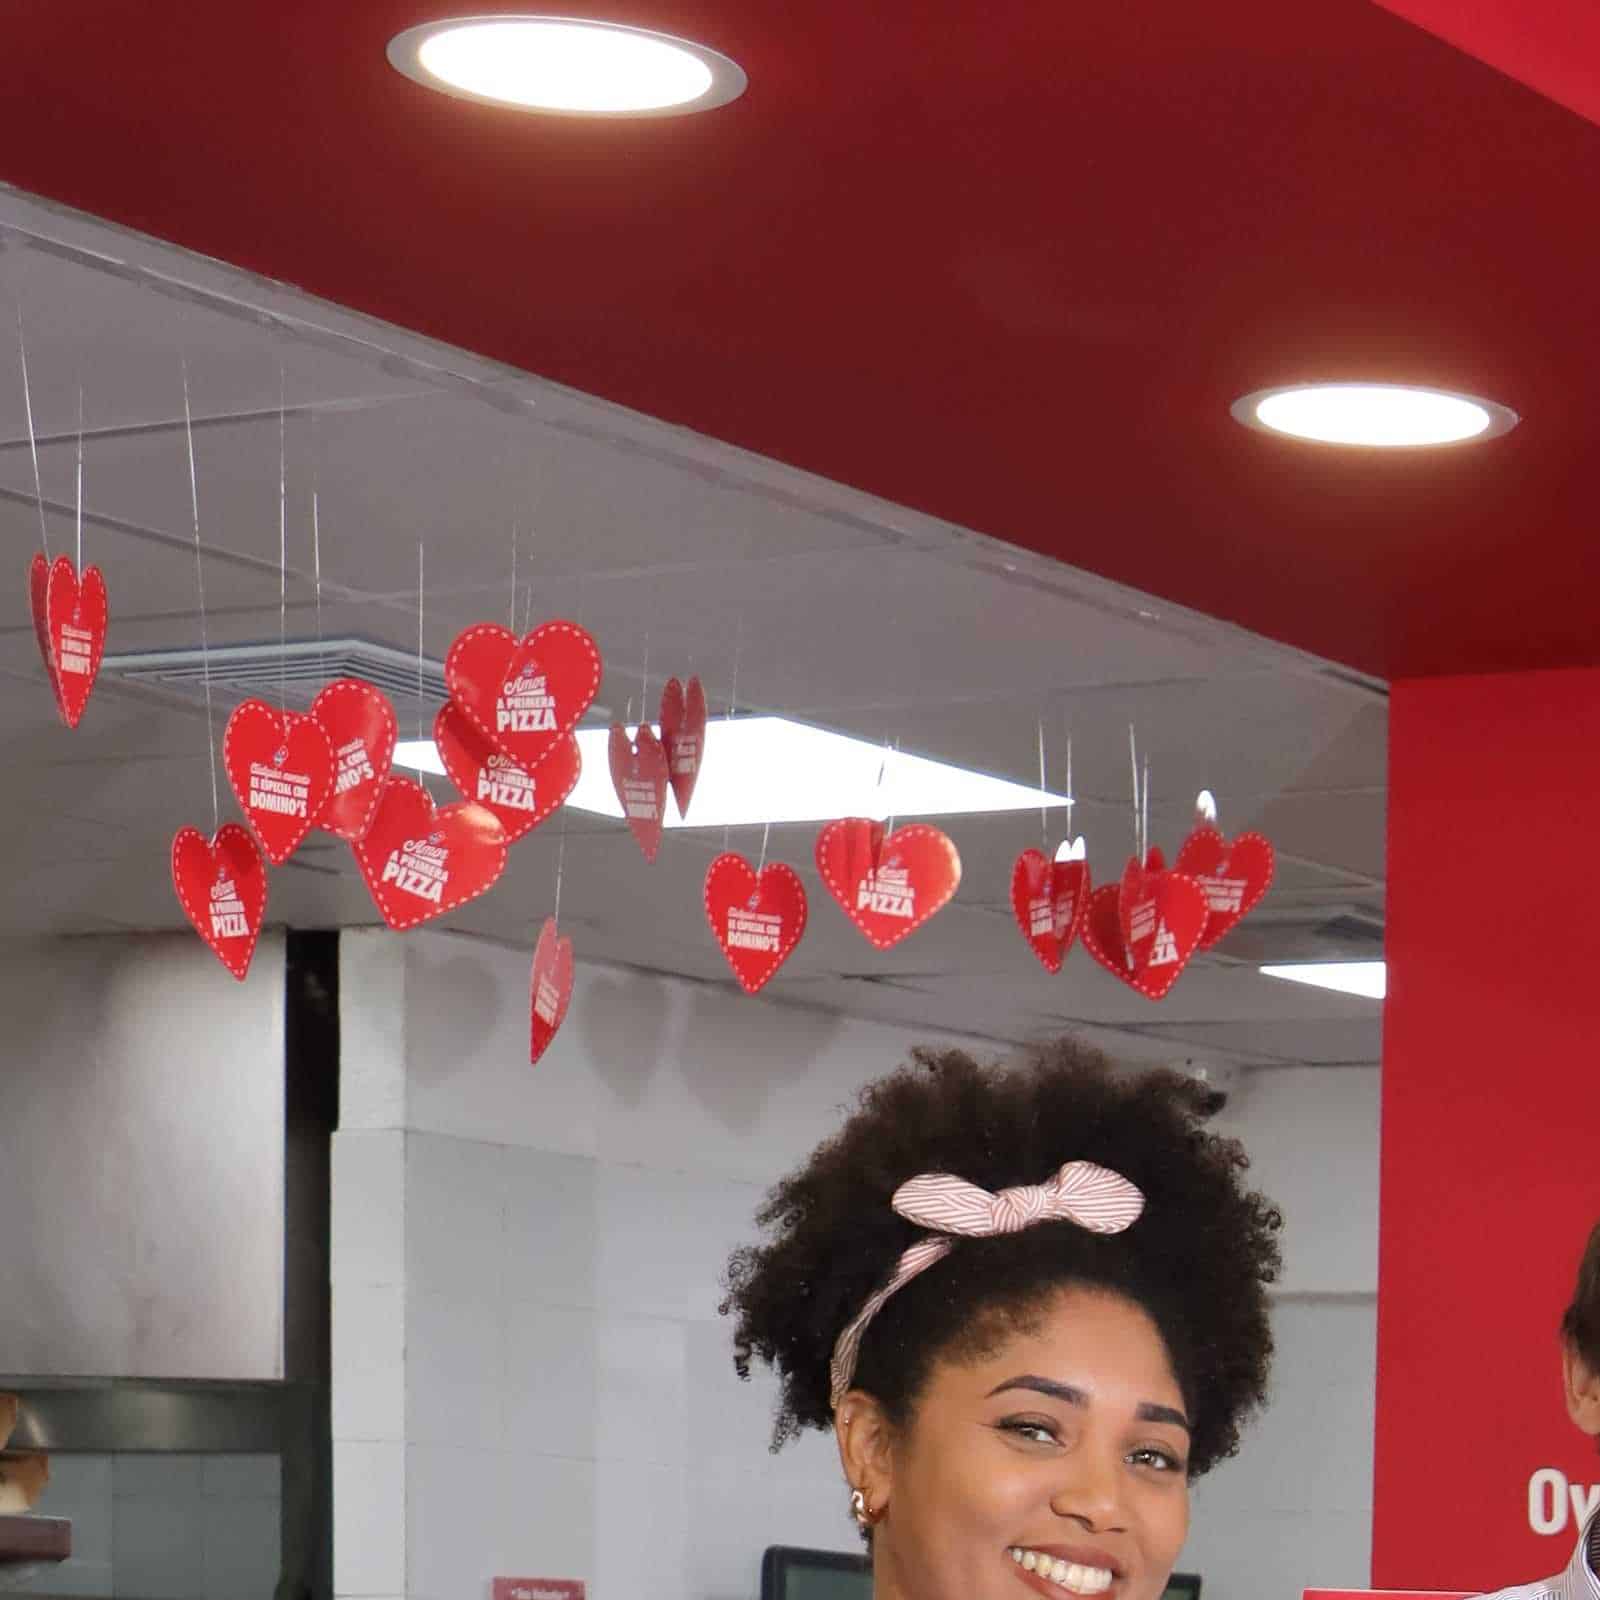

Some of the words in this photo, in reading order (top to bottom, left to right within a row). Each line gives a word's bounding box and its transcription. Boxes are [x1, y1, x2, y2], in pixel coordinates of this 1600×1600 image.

[496, 698, 506, 709] A
[496, 709, 558, 732] PIZZA
[249, 789, 307, 819] DOMINO'S
[477, 778, 536, 812] PIZZA
[381, 860, 442, 904] PIZZA
[857, 890, 914, 919] PIZZA
[211, 913, 251, 939] PIZZA
